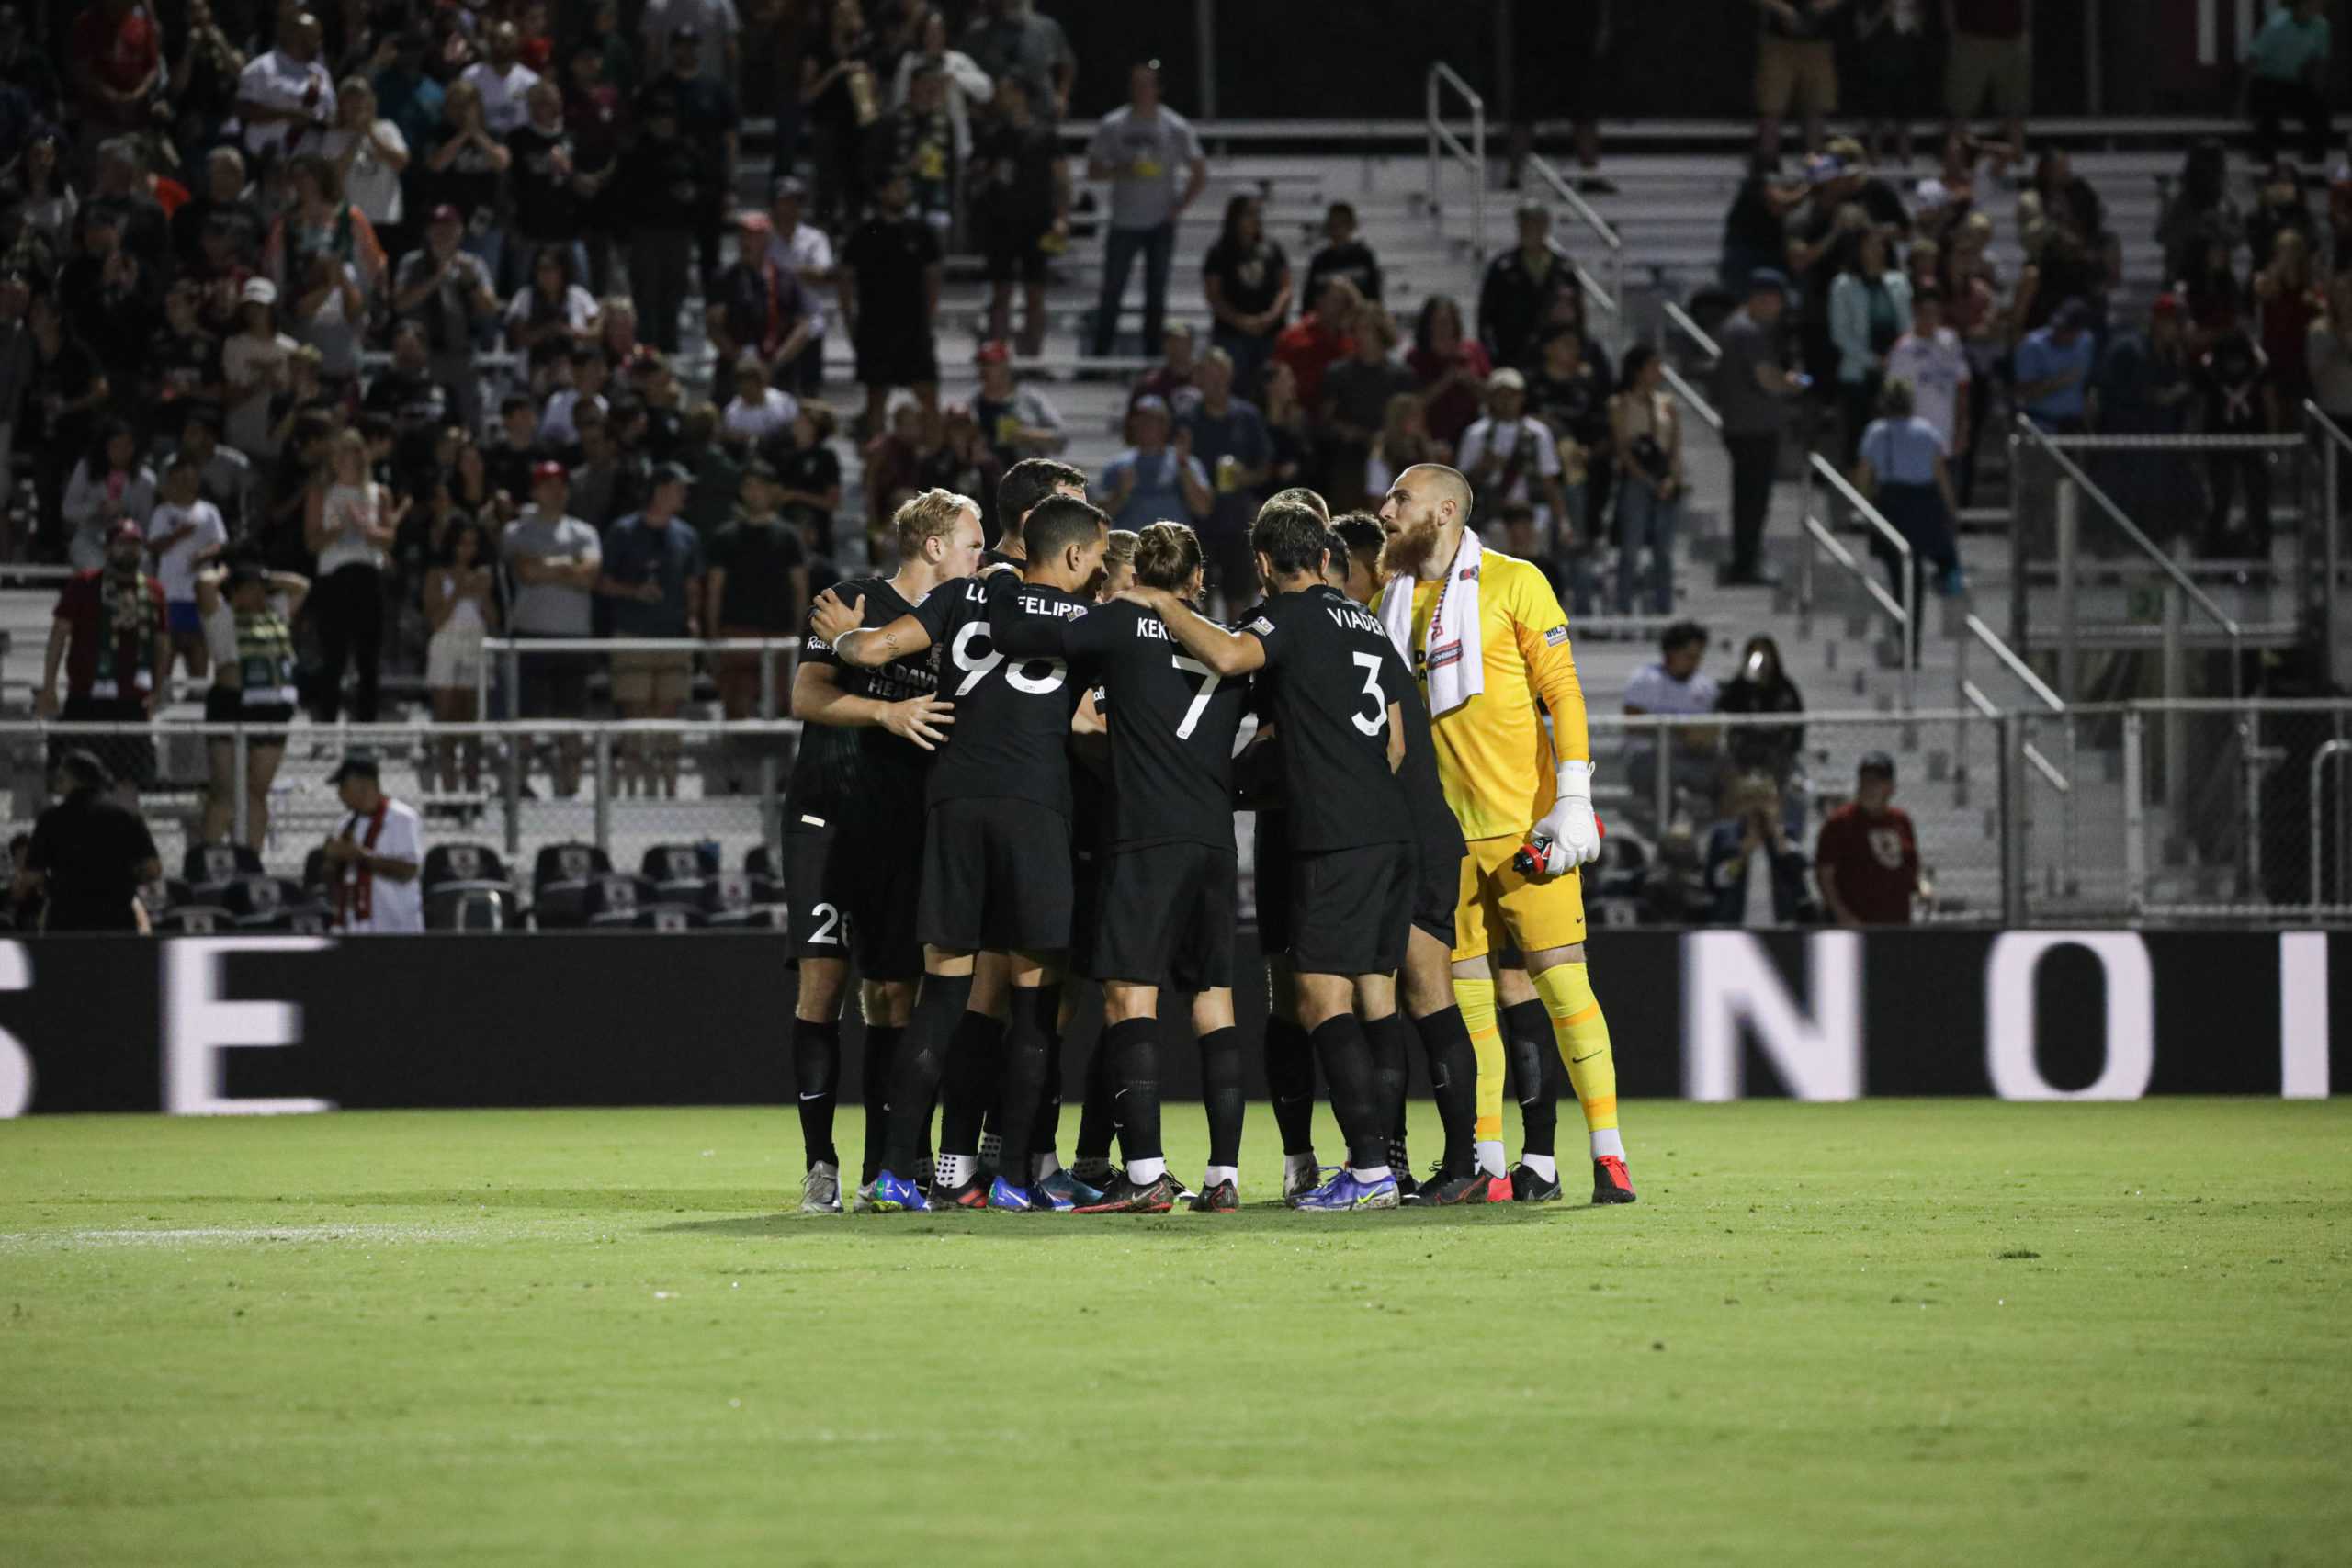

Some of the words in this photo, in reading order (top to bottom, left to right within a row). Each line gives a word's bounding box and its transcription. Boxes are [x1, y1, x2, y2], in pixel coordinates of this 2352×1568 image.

[965, 583, 988, 604] LU
[1171, 654, 1222, 740] 7
[1351, 651, 1388, 737] 3
